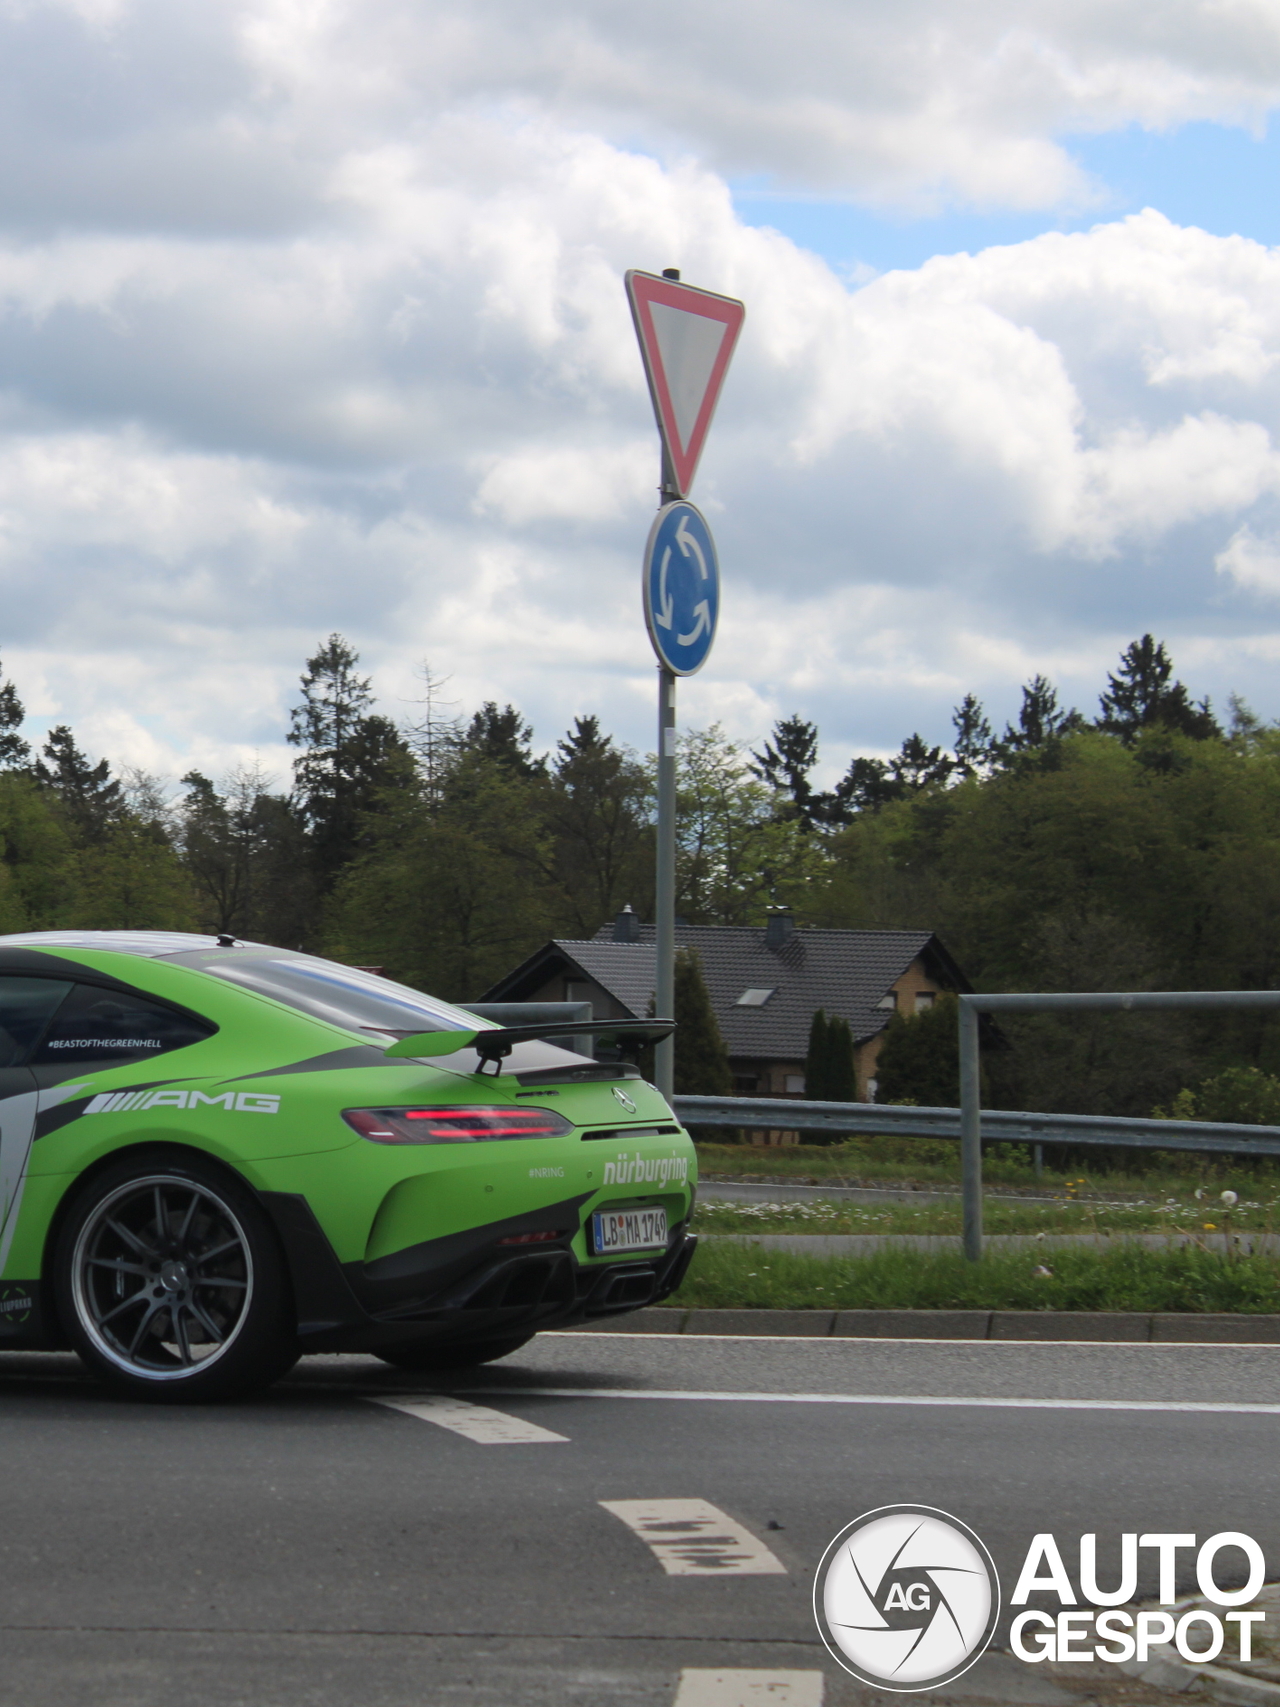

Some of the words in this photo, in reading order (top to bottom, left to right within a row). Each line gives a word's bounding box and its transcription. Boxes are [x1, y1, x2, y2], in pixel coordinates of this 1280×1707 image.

[48, 1039, 161, 1048] #BEASTOFTHEGREENHELL
[141, 1090, 281, 1113] AMG
[528, 1167, 564, 1178] #NRING
[603, 1150, 688, 1188] nürburgring
[602, 1216, 618, 1246] LB
[625, 1214, 641, 1244] MA
[642, 1212, 666, 1242] 1749
